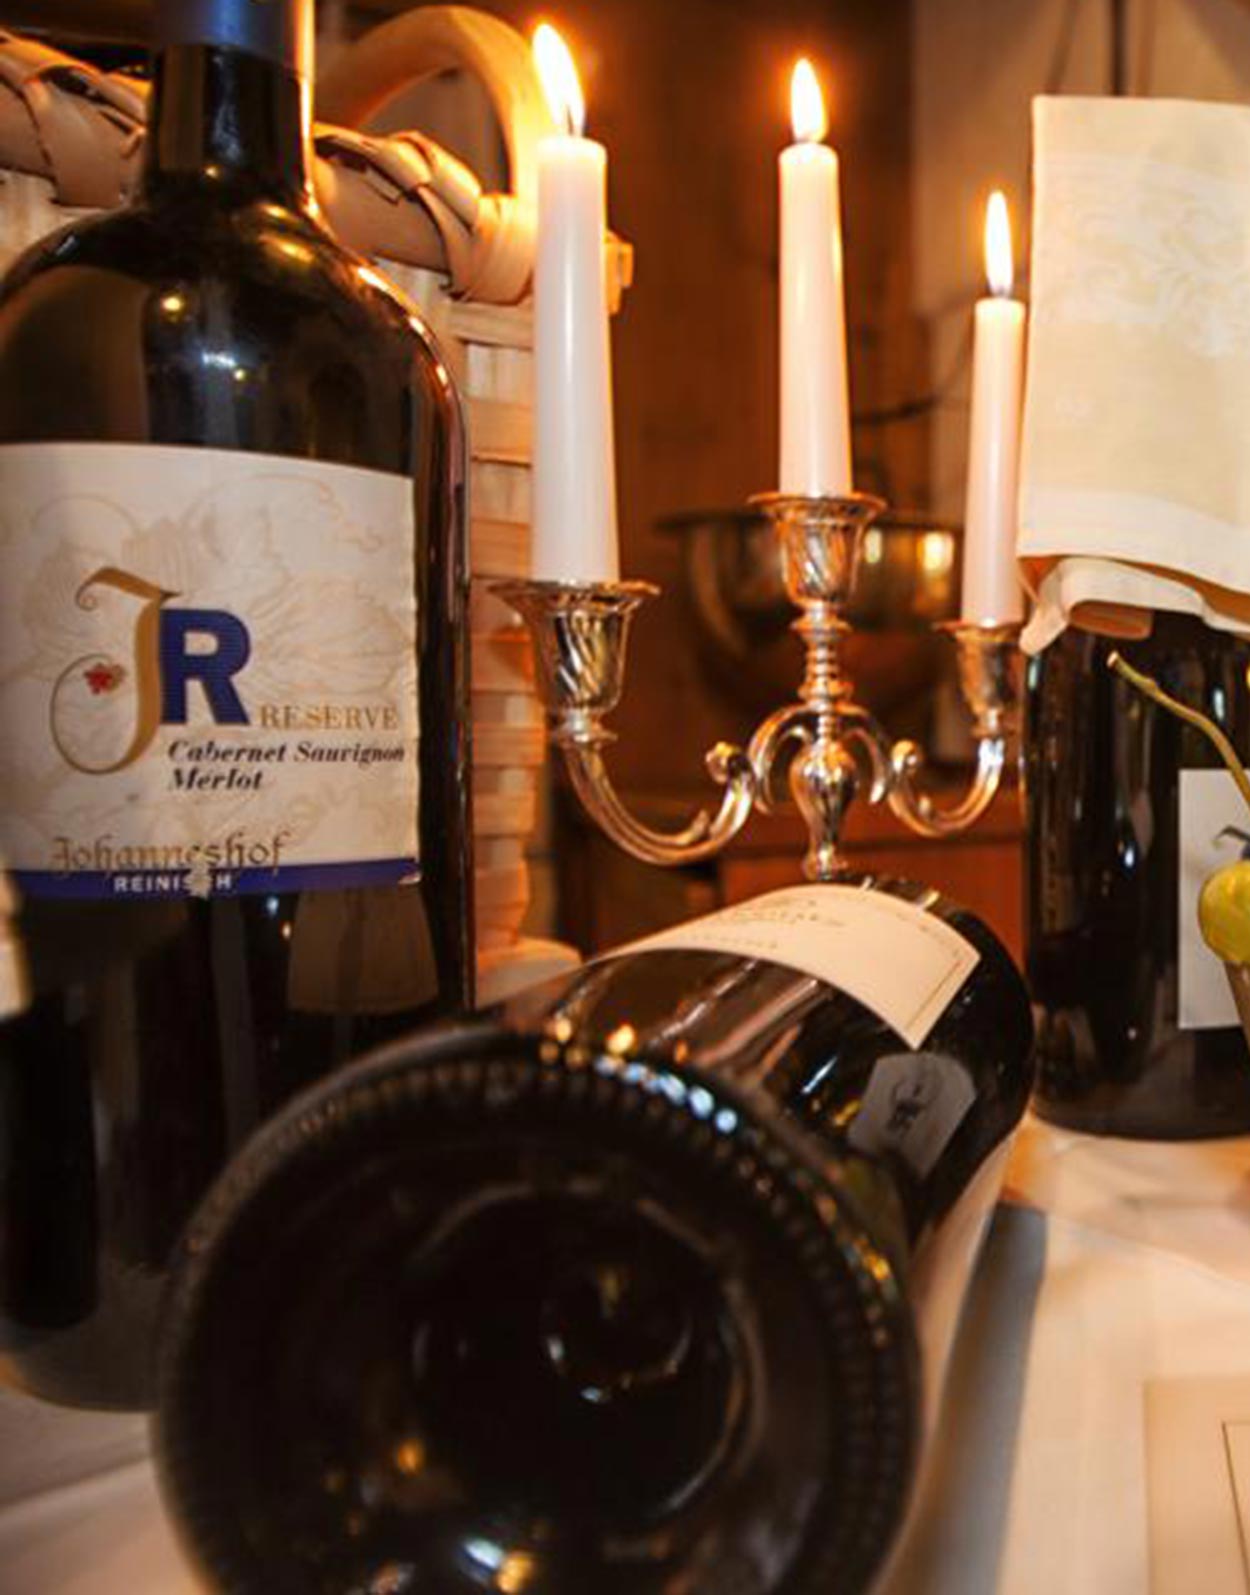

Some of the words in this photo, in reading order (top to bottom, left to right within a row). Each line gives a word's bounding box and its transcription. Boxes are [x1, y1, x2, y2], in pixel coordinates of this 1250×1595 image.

[259, 703, 399, 731] RESERVE
[167, 739, 287, 764] Cabernet
[293, 741, 405, 770] Sauvignon
[168, 767, 263, 791] Merlot
[51, 830, 291, 879] Johanneshof
[113, 873, 233, 894] REINISH
